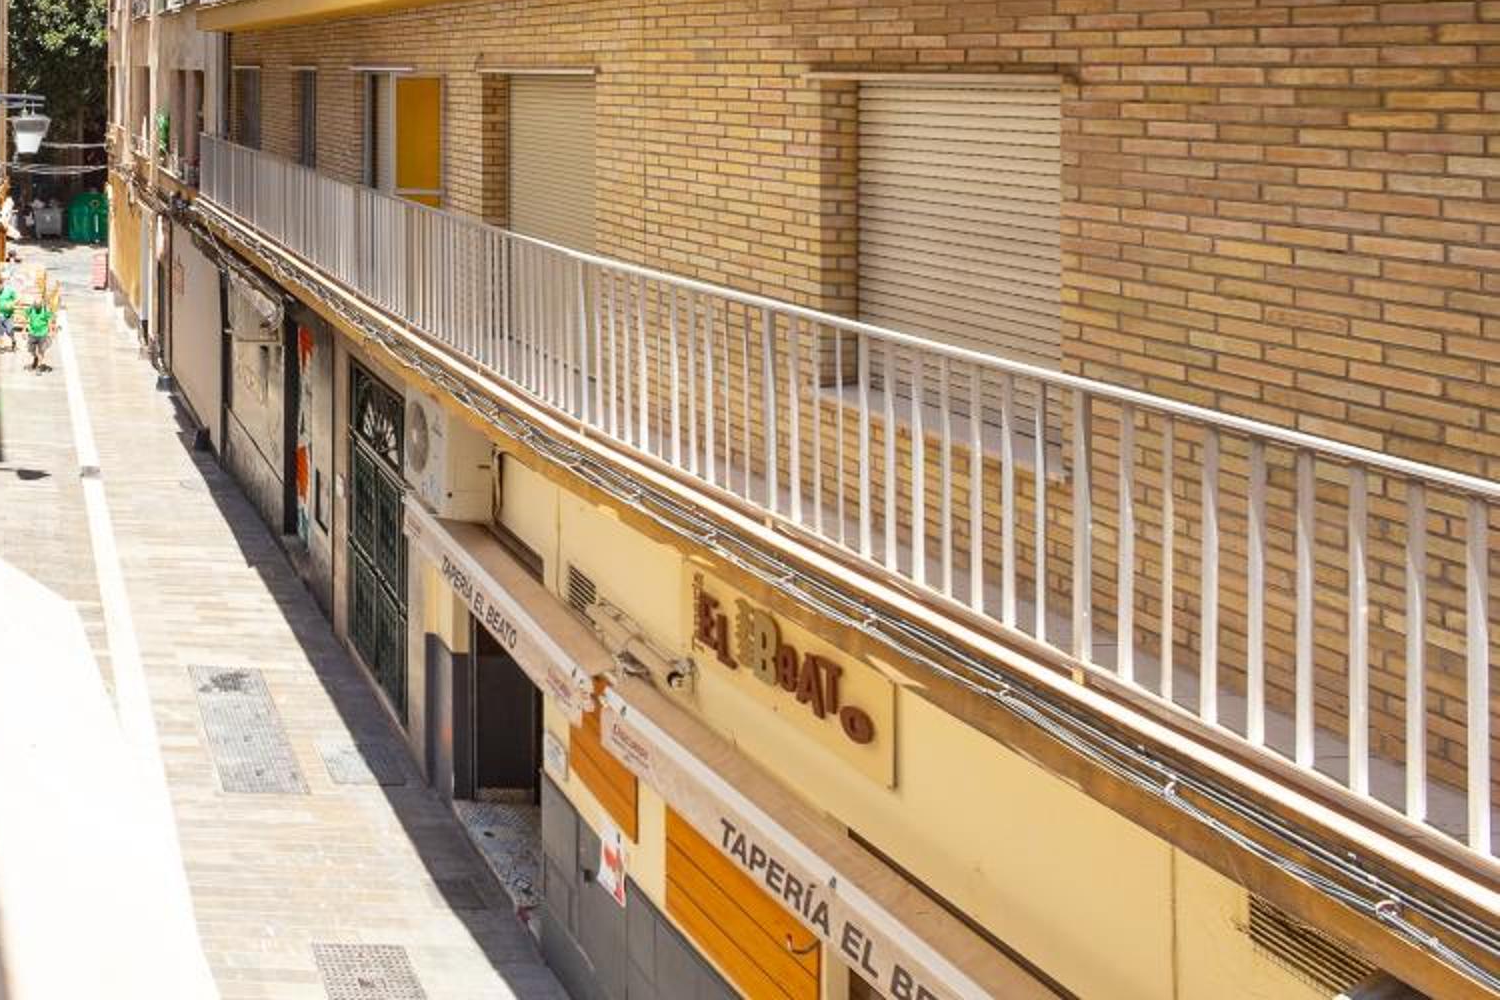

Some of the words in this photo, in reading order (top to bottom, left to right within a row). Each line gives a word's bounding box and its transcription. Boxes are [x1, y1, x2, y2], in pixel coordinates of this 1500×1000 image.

[473, 591, 485, 617] EL
[485, 604, 517, 649] BEATO
[700, 590, 739, 670] EL
[719, 817, 832, 938] TAPERÍA
[840, 920, 880, 980] EL
